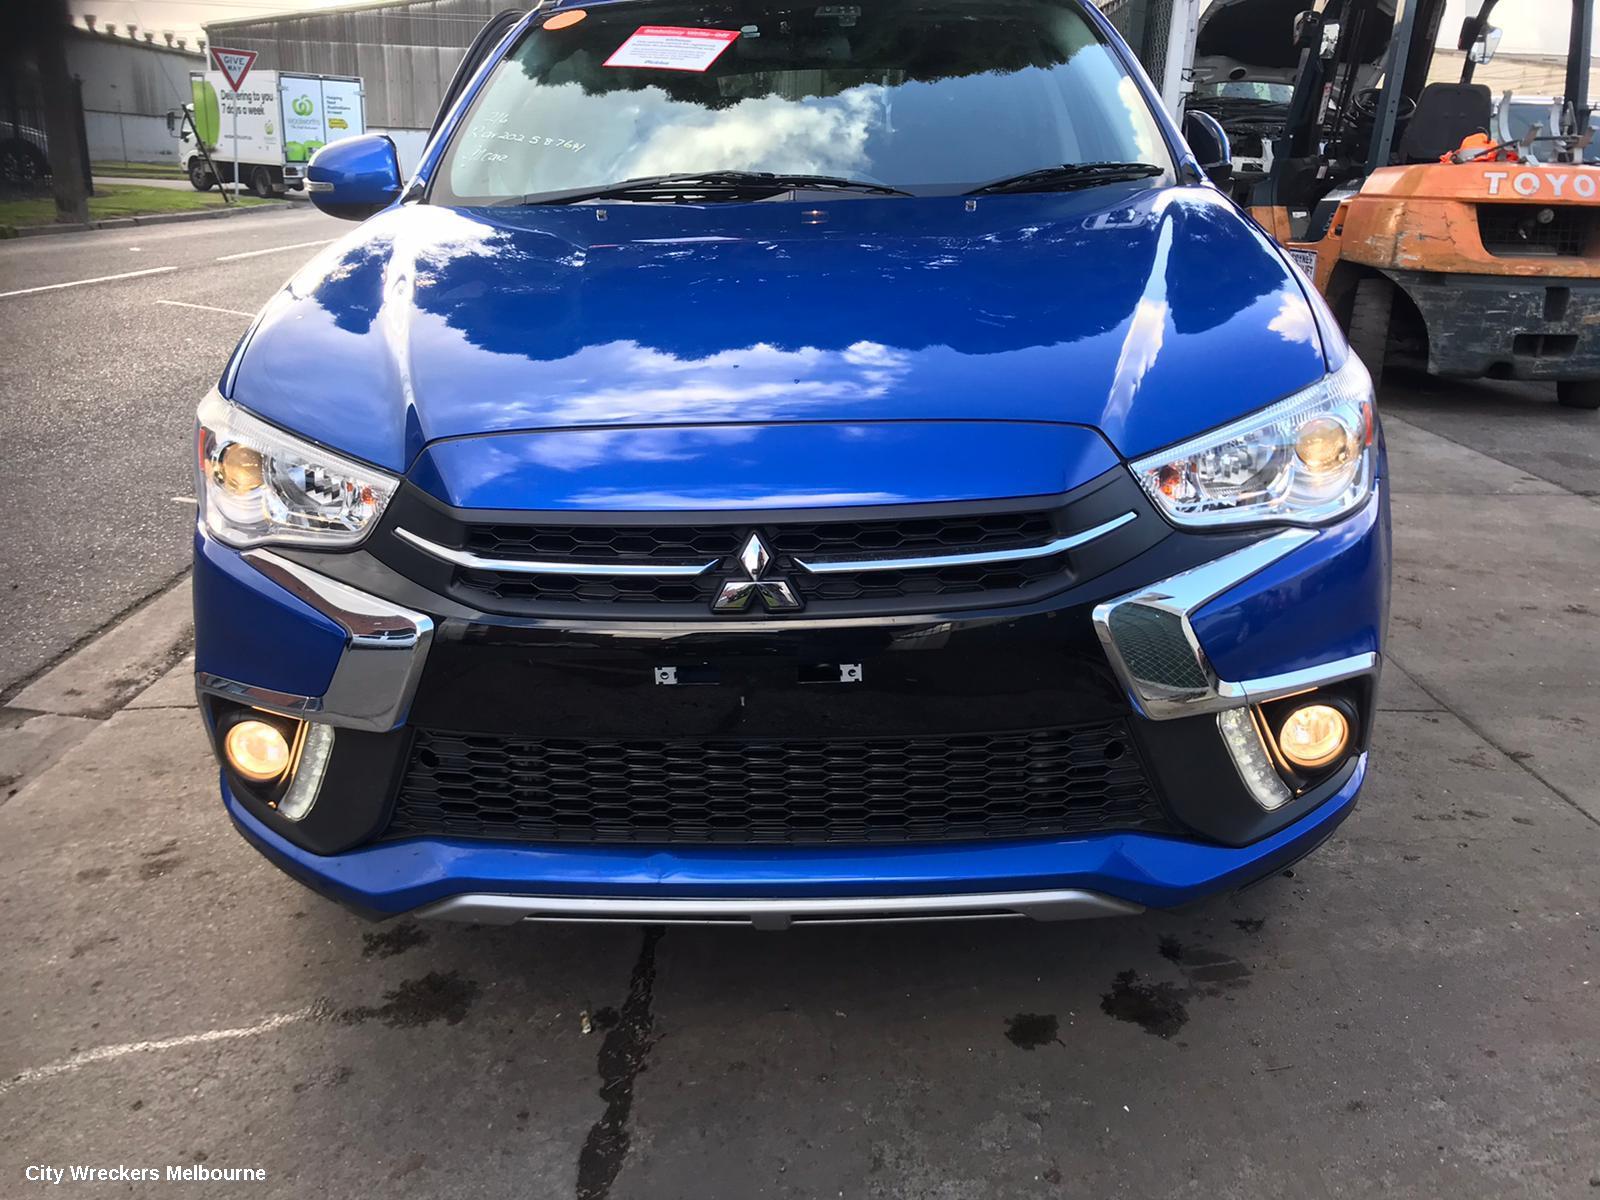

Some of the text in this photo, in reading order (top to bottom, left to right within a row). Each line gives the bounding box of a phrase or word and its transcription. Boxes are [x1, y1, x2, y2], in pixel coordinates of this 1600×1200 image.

[223, 56, 245, 66] GIVE
[253, 92, 261, 101] to
[261, 93, 273, 104] you
[221, 103, 226, 114] 7
[242, 106, 247, 115] a
[1484, 171, 1600, 197] TOYO
